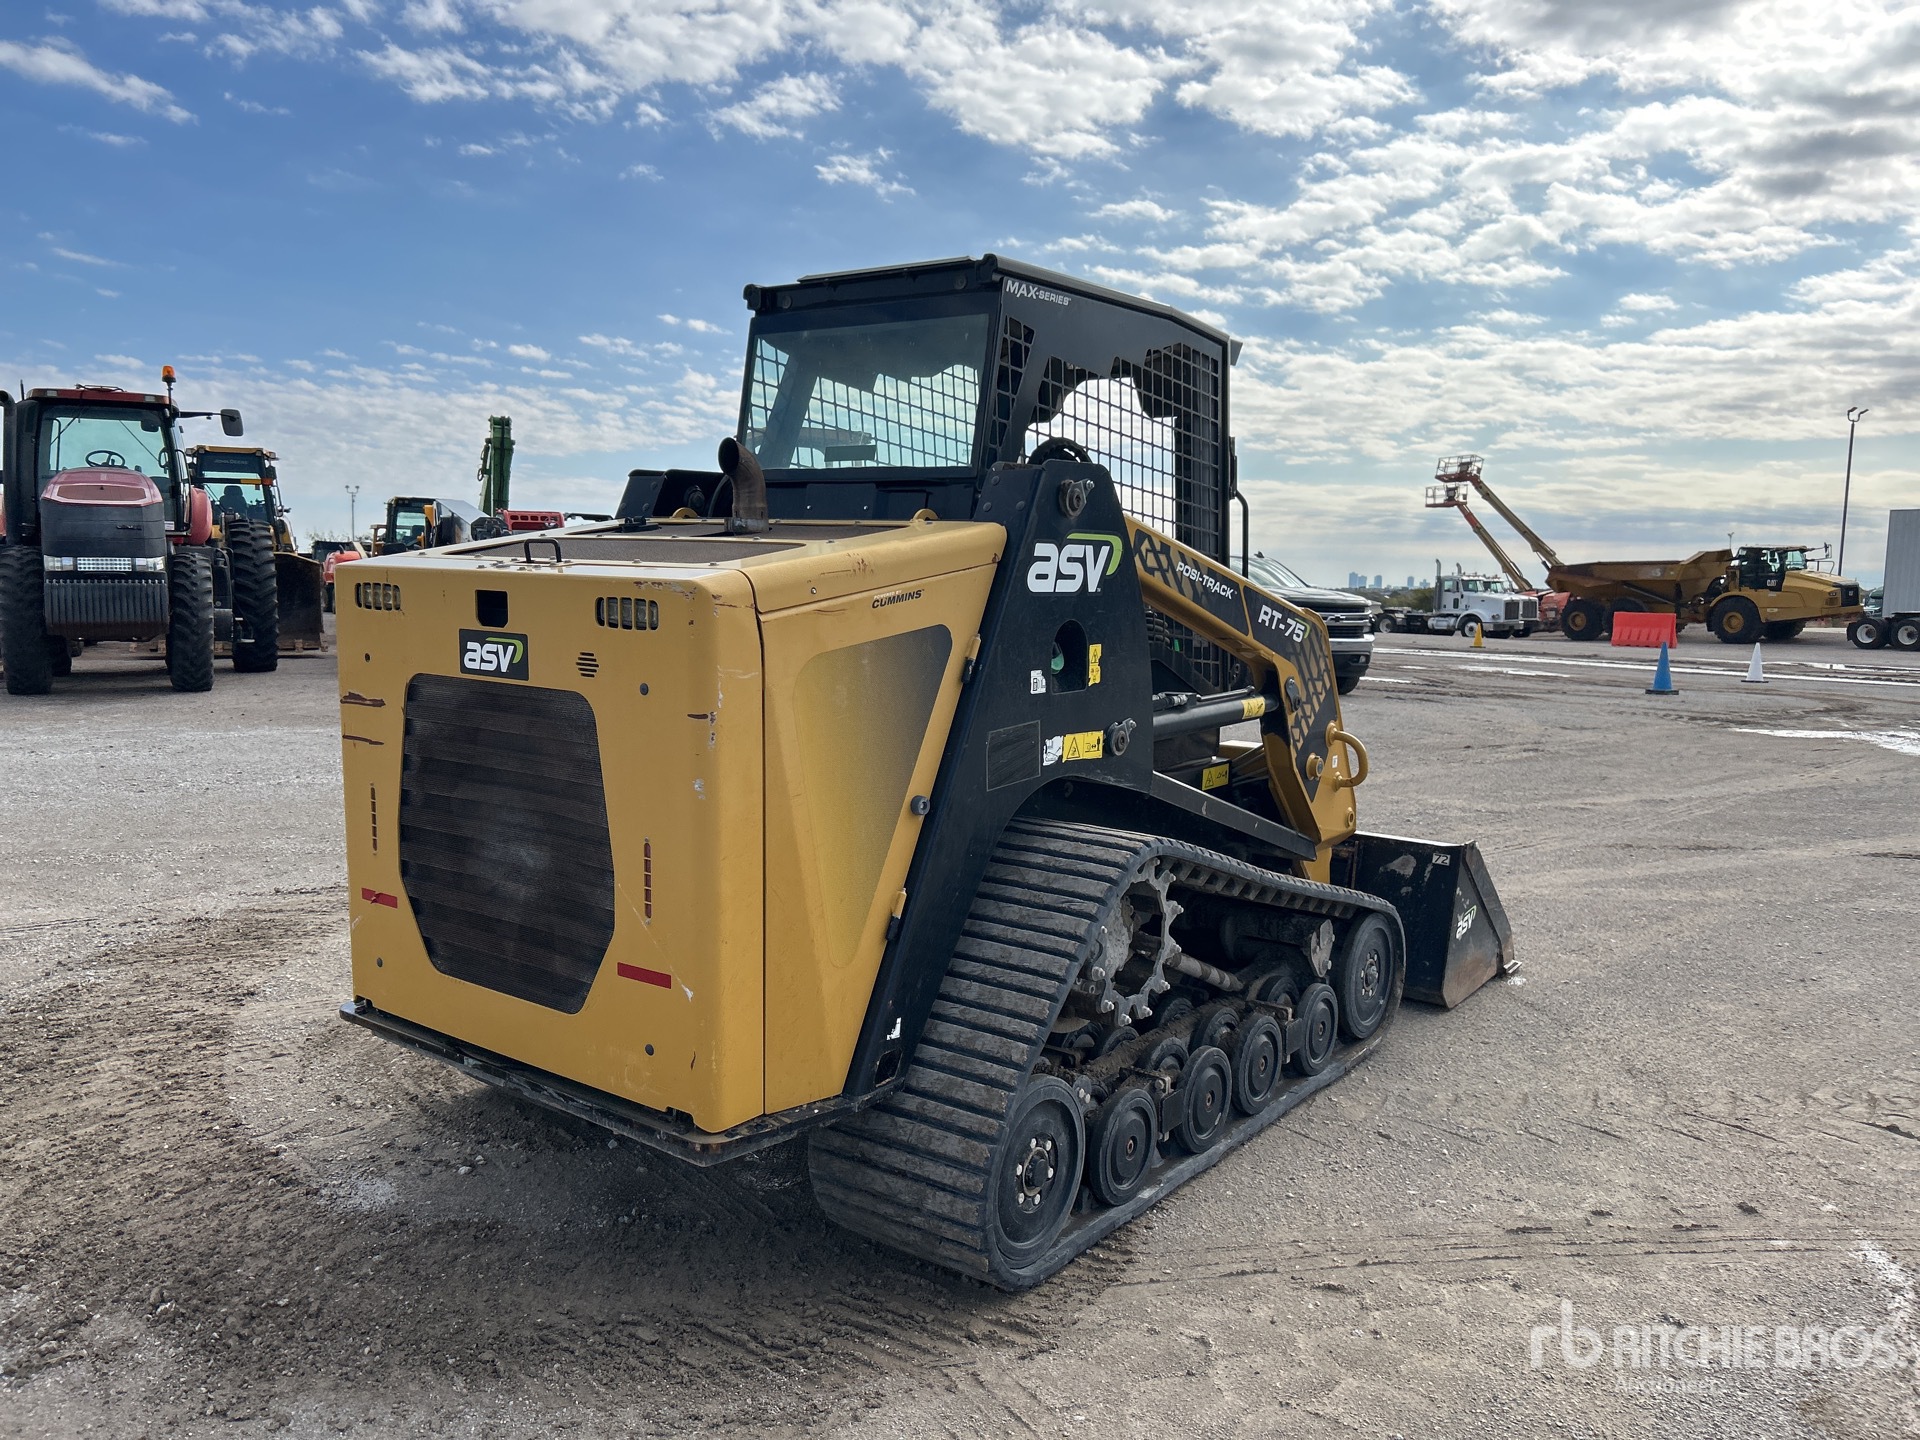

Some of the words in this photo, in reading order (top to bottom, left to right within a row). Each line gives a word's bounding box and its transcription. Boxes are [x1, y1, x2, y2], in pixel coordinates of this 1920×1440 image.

[1176, 561, 1234, 599] POSI-TRACK
[872, 589, 922, 608] CUMMINS
[1258, 604, 1305, 643] RT-75
[1434, 853, 1449, 865] 72
